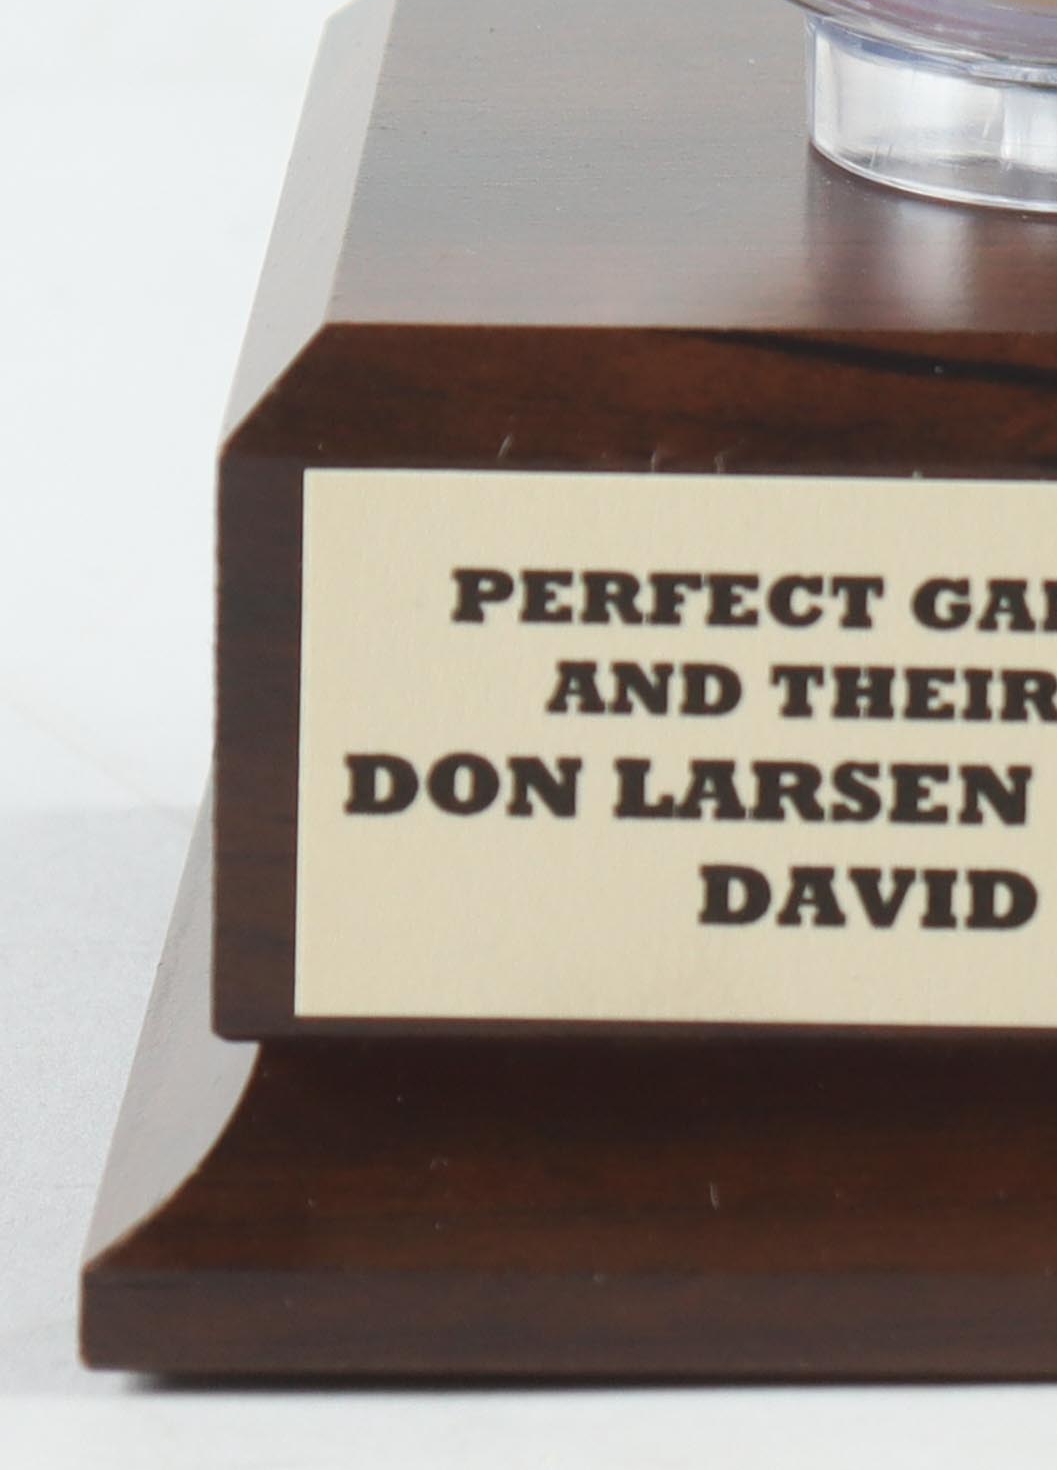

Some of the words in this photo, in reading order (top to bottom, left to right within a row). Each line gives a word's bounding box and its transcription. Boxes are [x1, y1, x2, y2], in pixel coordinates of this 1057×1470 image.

[453, 569, 884, 628] PERFECT
[548, 661, 741, 715] AND
[346, 754, 582, 817] DON
[615, 759, 1032, 825] LARSEN
[700, 865, 1037, 929] DAVID
